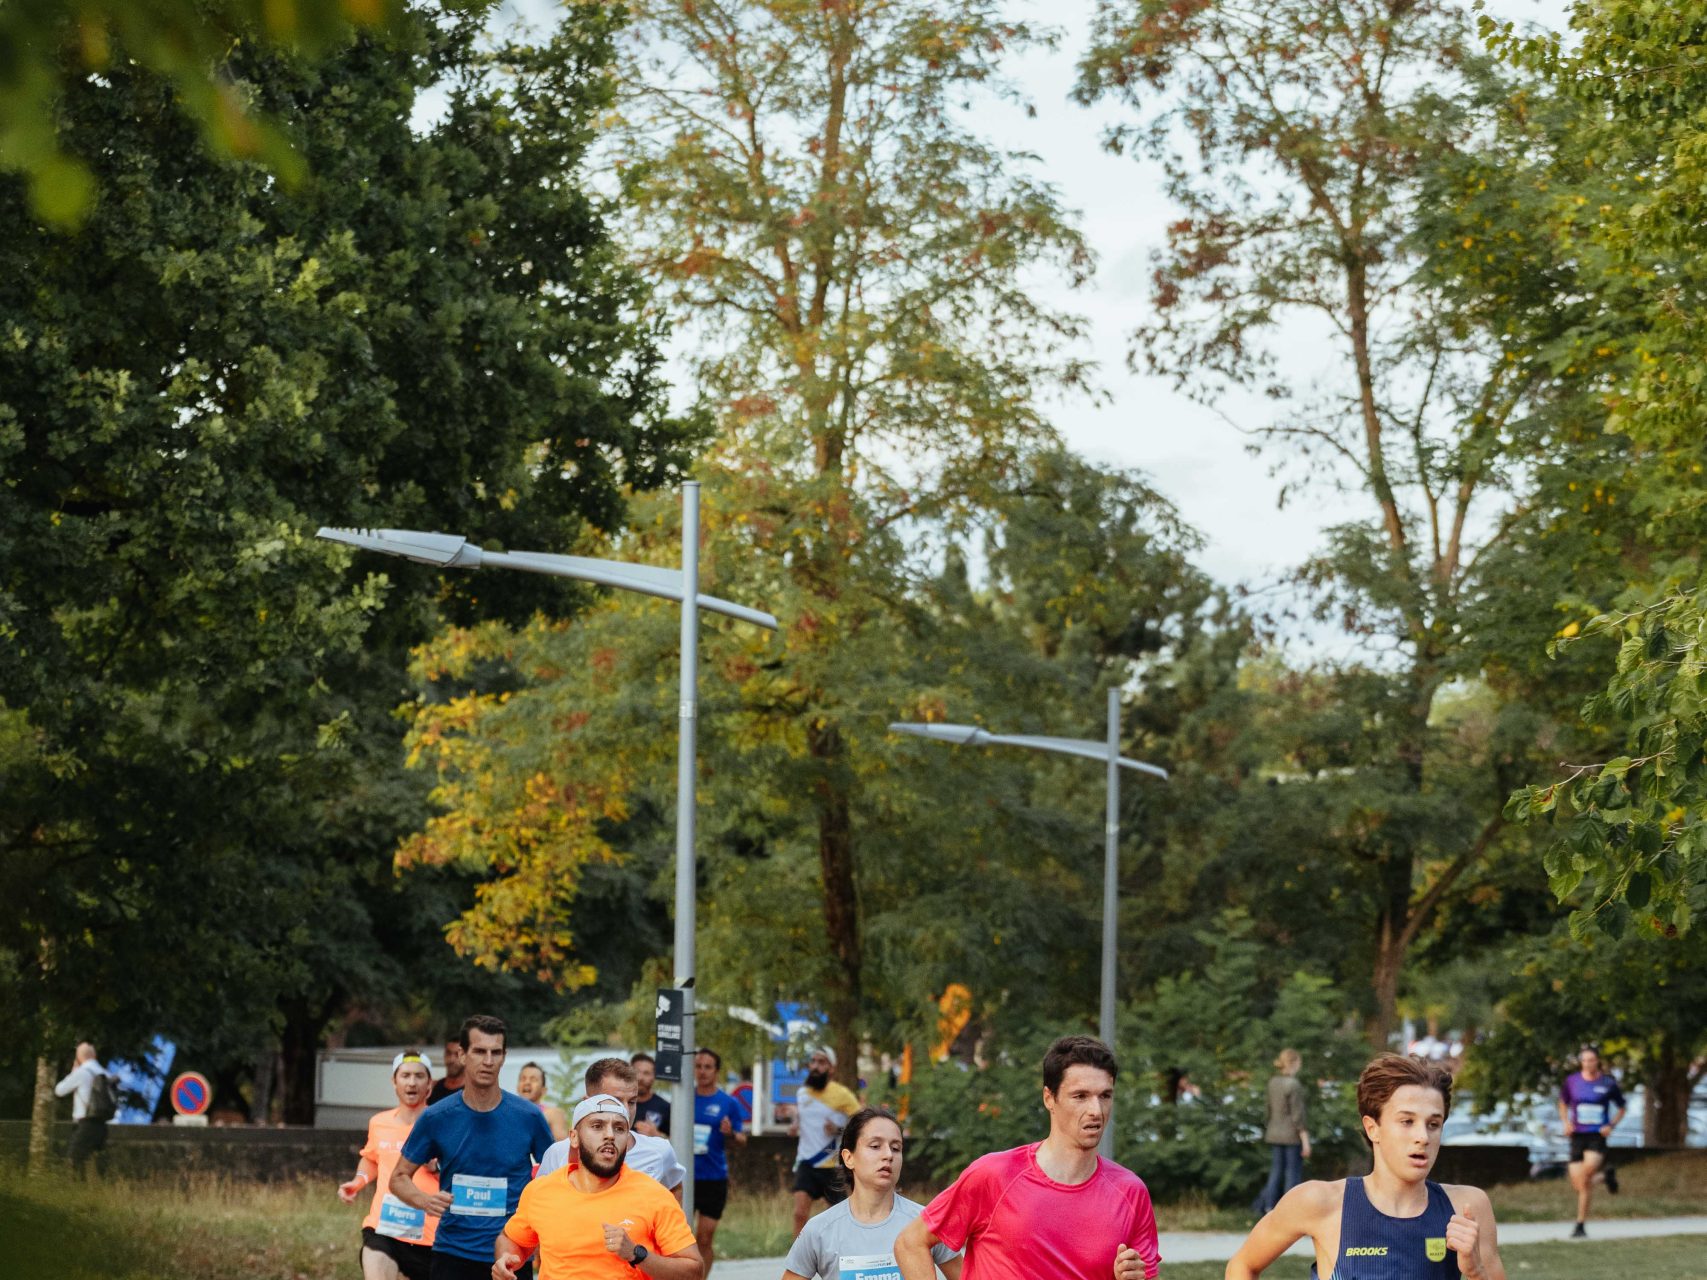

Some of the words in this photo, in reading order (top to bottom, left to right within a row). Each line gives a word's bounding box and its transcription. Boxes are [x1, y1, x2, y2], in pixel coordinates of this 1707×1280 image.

[466, 1188, 491, 1201] Paul
[388, 1206, 416, 1220] Pierre
[1345, 1247, 1389, 1256] BROOKS
